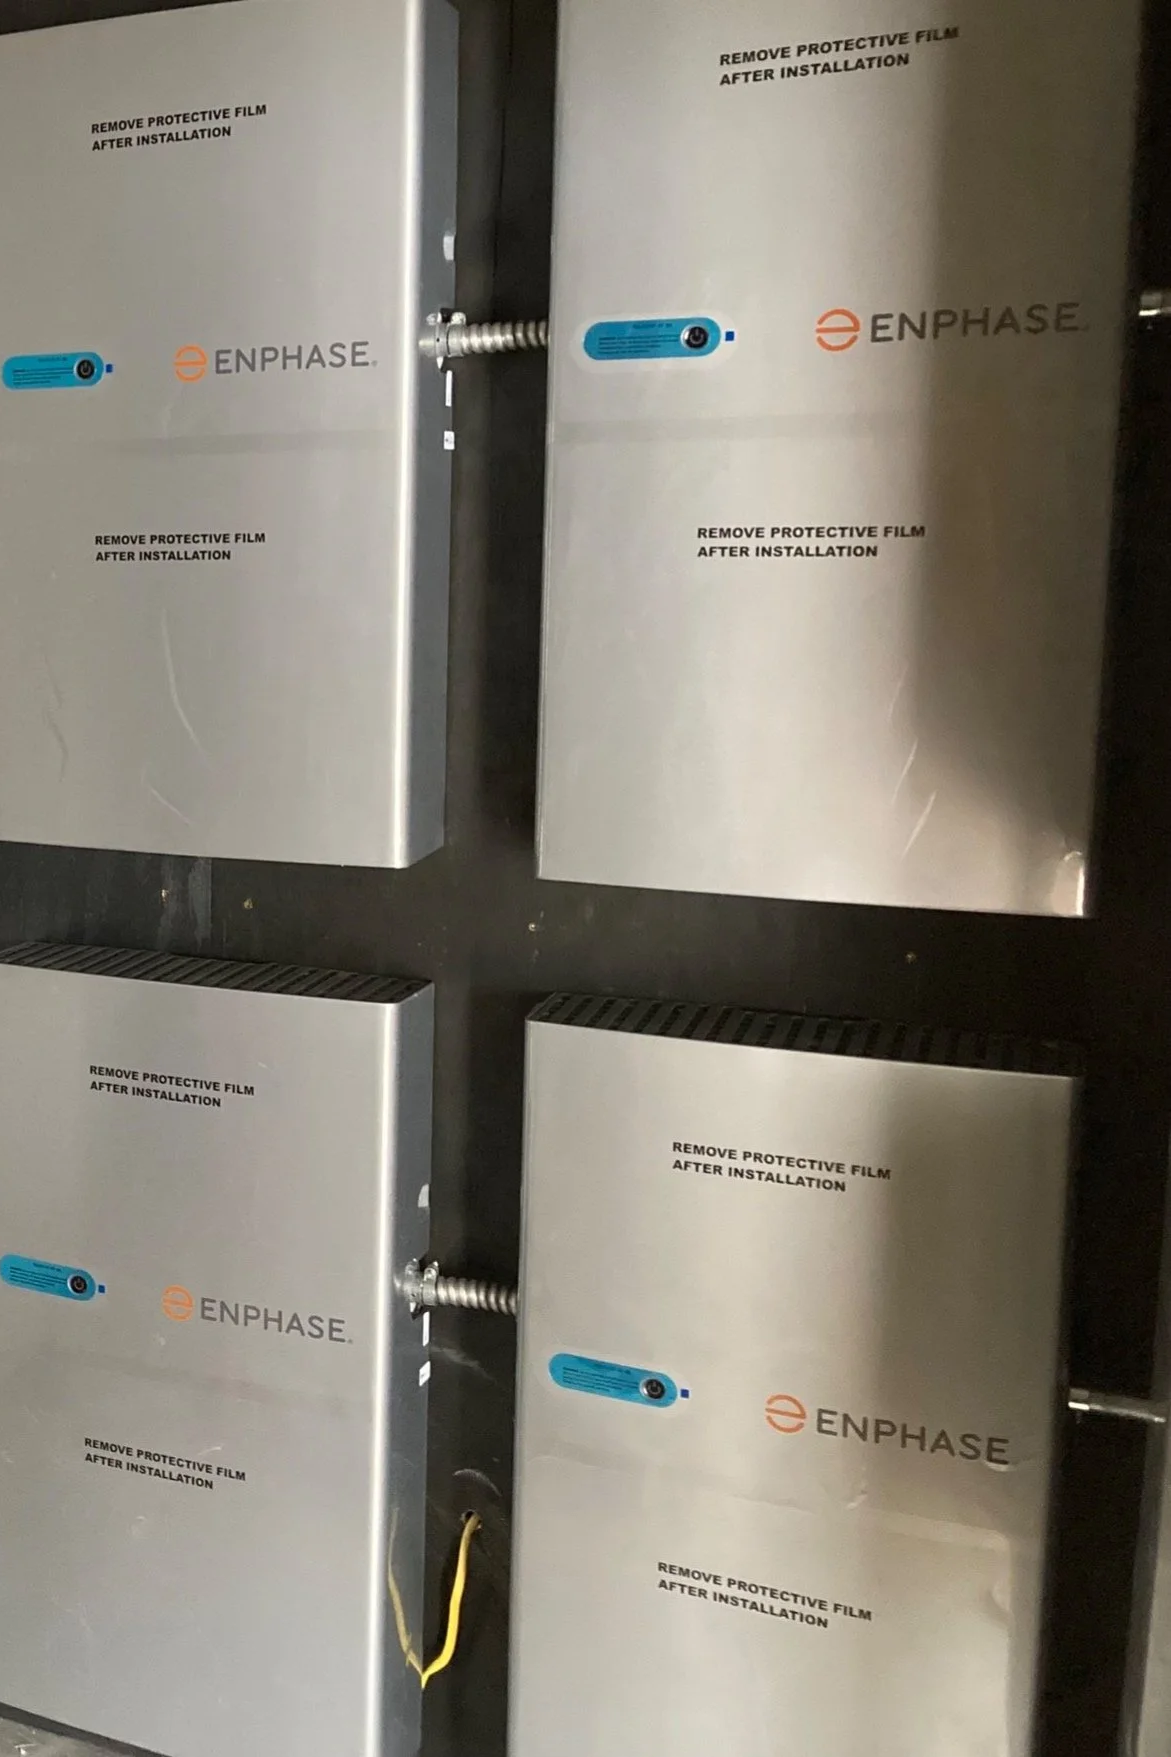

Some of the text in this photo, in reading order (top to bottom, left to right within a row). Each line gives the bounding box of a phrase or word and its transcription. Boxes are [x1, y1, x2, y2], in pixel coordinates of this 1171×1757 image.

[720, 27, 960, 66] REMOVE PROTECTIVE FILM
[719, 53, 910, 86] AFTER INSTALLATION
[91, 104, 266, 134] REMOVE PROTECTIVE FILM
[92, 127, 231, 151] AFTER INSTALLATION
[95, 533, 265, 545] REMOVE PROTECTIVE FILM
[697, 525, 925, 538] REMOVE PROTECTIVE FILM
[96, 550, 231, 561] AFTER INSTALLATION
[697, 546, 877, 557] AFTER INSTALLATION
[90, 1065, 254, 1096] REMOVE PROTECTIVE FILM
[90, 1081, 221, 1107] AFTER INSTALLATION
[673, 1142, 891, 1180] REMOVE PROTECTIVE FILM
[673, 1160, 846, 1192] AFTER INSTALLATION
[816, 1408, 1010, 1465] ENPHASE
[84, 1438, 246, 1481] REMOVE PROTECTIVE FILM
[85, 1453, 213, 1489] AFTER INSTALLATION
[658, 1562, 872, 1620] REMOVE PROTECTIVE FILM
[658, 1579, 828, 1628] AFTER INSTALLATION
